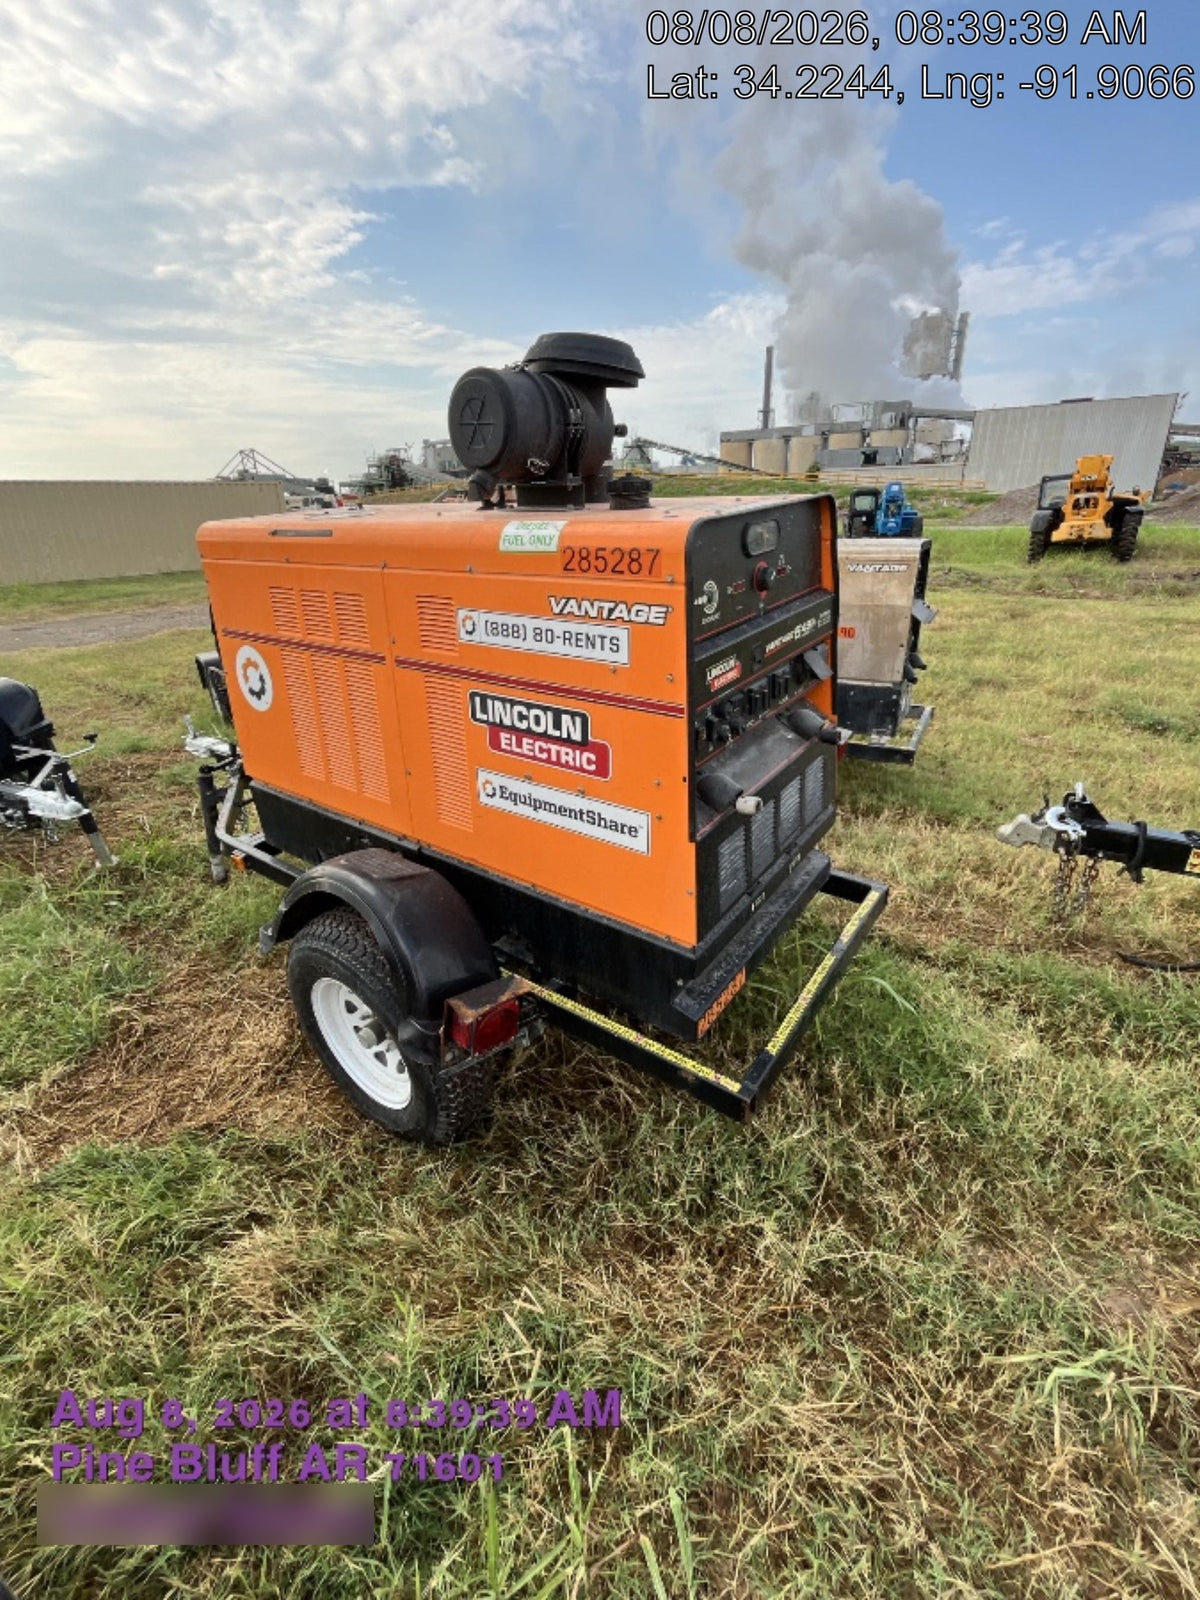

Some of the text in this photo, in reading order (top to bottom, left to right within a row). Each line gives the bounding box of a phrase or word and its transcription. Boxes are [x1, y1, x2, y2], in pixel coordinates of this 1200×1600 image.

[502, 534, 556, 547] FUEL ONLY
[562, 546, 661, 576] 285287
[548, 596, 668, 626] VANTAGE
[484, 619, 620, 654] (888) 80-RENTS
[474, 695, 583, 742] LINCOLN
[499, 731, 597, 772] ELECTRIC
[498, 784, 640, 838] EquipmentShare
